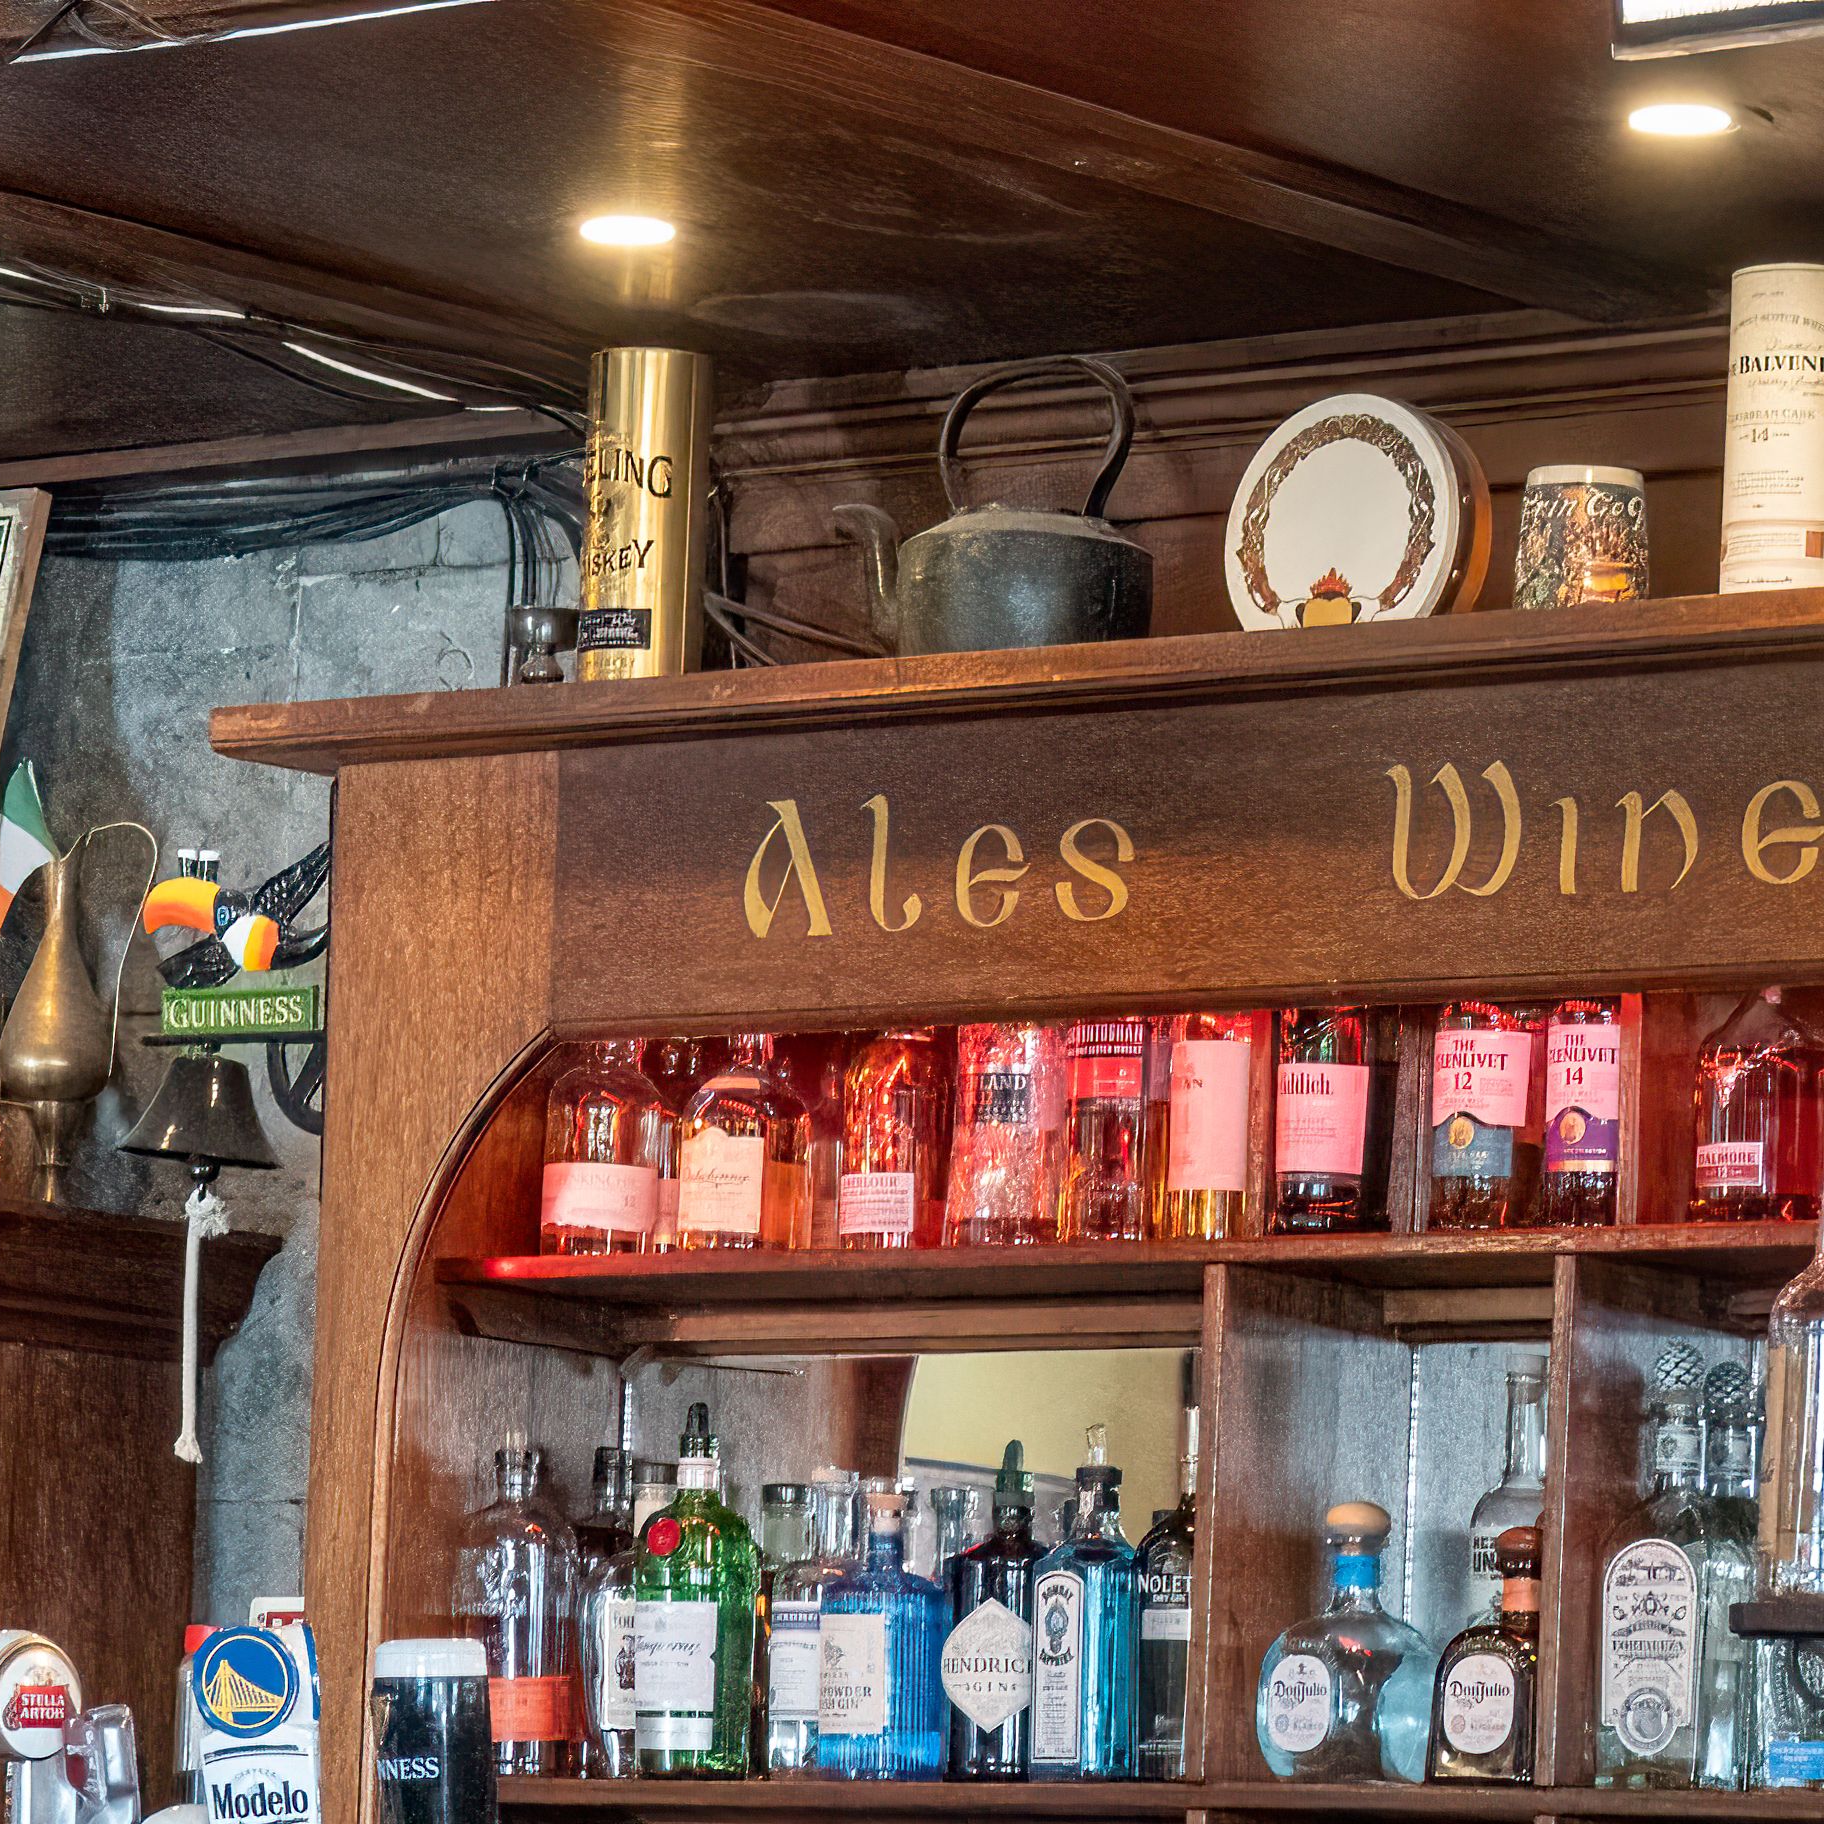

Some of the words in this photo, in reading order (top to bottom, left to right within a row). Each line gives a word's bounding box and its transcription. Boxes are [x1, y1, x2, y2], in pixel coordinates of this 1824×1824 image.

[741, 793, 1137, 940] Ales
[169, 995, 305, 1029] GUINNESS
[1454, 1072, 1473, 1090] 12
[1565, 1067, 1584, 1085] 14
[20, 1693, 66, 1707] STELLA
[20, 1706, 66, 1720] ARTOIS
[211, 1780, 309, 1821] Modelo
